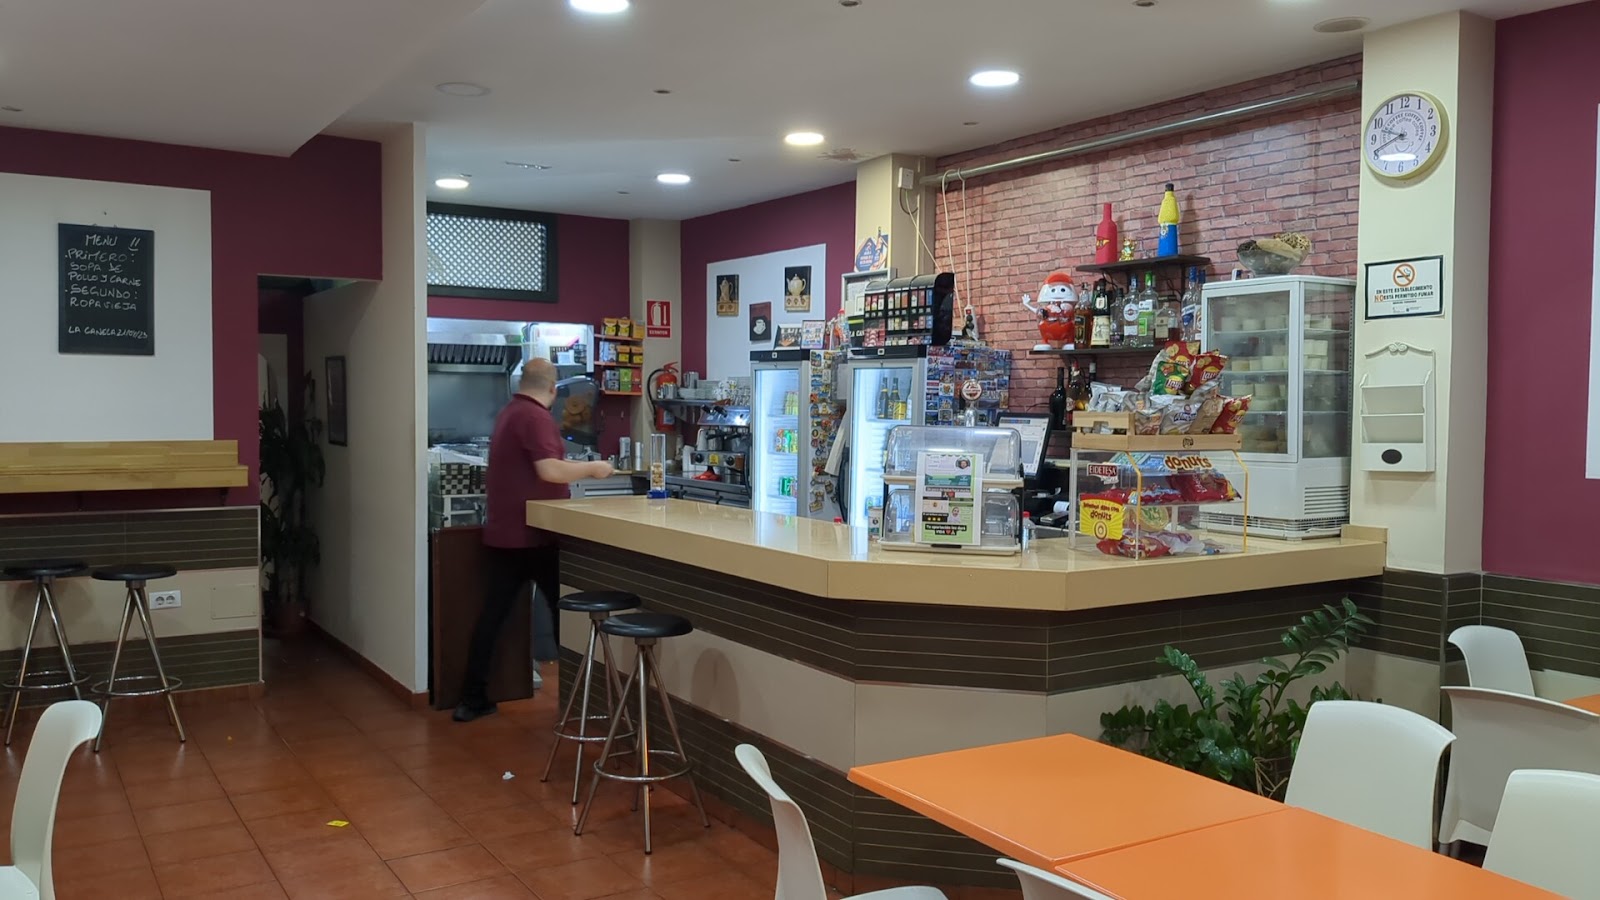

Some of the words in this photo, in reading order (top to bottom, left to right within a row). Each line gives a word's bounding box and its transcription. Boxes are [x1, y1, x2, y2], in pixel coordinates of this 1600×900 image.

[1400, 96, 1410, 109] 12
[1385, 103, 1394, 115] 11
[1427, 108, 1434, 120] 2
[1374, 117, 1383, 130] 10
[1430, 125, 1436, 137] 3
[1371, 134, 1377, 145] 9
[1425, 141, 1431, 153] 4
[1384, 161, 1388, 171] 7
[1398, 161, 1404, 173] 6
[85, 234, 118, 247] MENU
[70, 261, 101, 272] SOPA
[108, 262, 123, 273] DE
[68, 271, 98, 282] POLLO
[109, 274, 142, 287] CARNE
[70, 296, 101, 308] ROPA
[1375, 294, 1383, 302] NO
[68, 325, 81, 334] LA
[84, 326, 116, 336] CANELA
[1165, 455, 1212, 469] donuts
[1090, 510, 1112, 521] donuts
